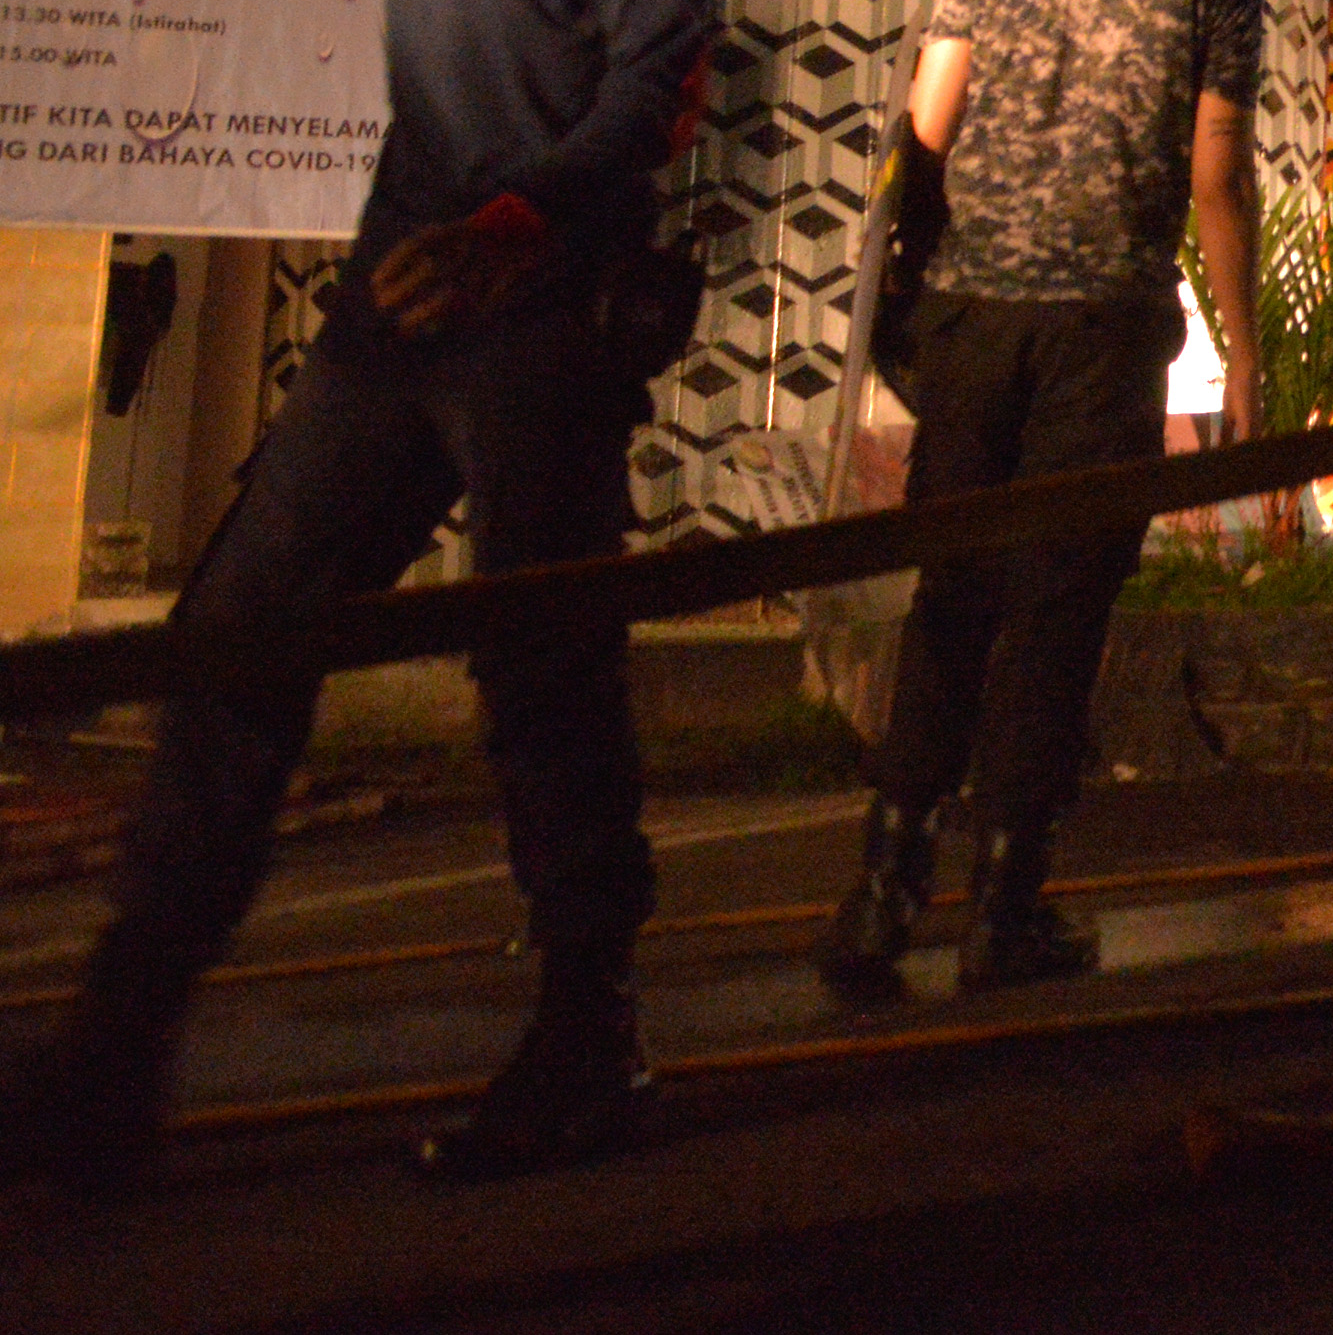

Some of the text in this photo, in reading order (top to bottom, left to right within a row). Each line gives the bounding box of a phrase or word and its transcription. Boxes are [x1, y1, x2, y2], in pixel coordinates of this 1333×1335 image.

[68, 9, 122, 29] WITA
[129, 12, 227, 37] (Istirahat)
[63, 48, 118, 67] WITA
[46, 106, 113, 128] KITA
[124, 109, 216, 133] DAPAT
[37, 141, 109, 164] DARI
[118, 144, 235, 168] BAHAYA
